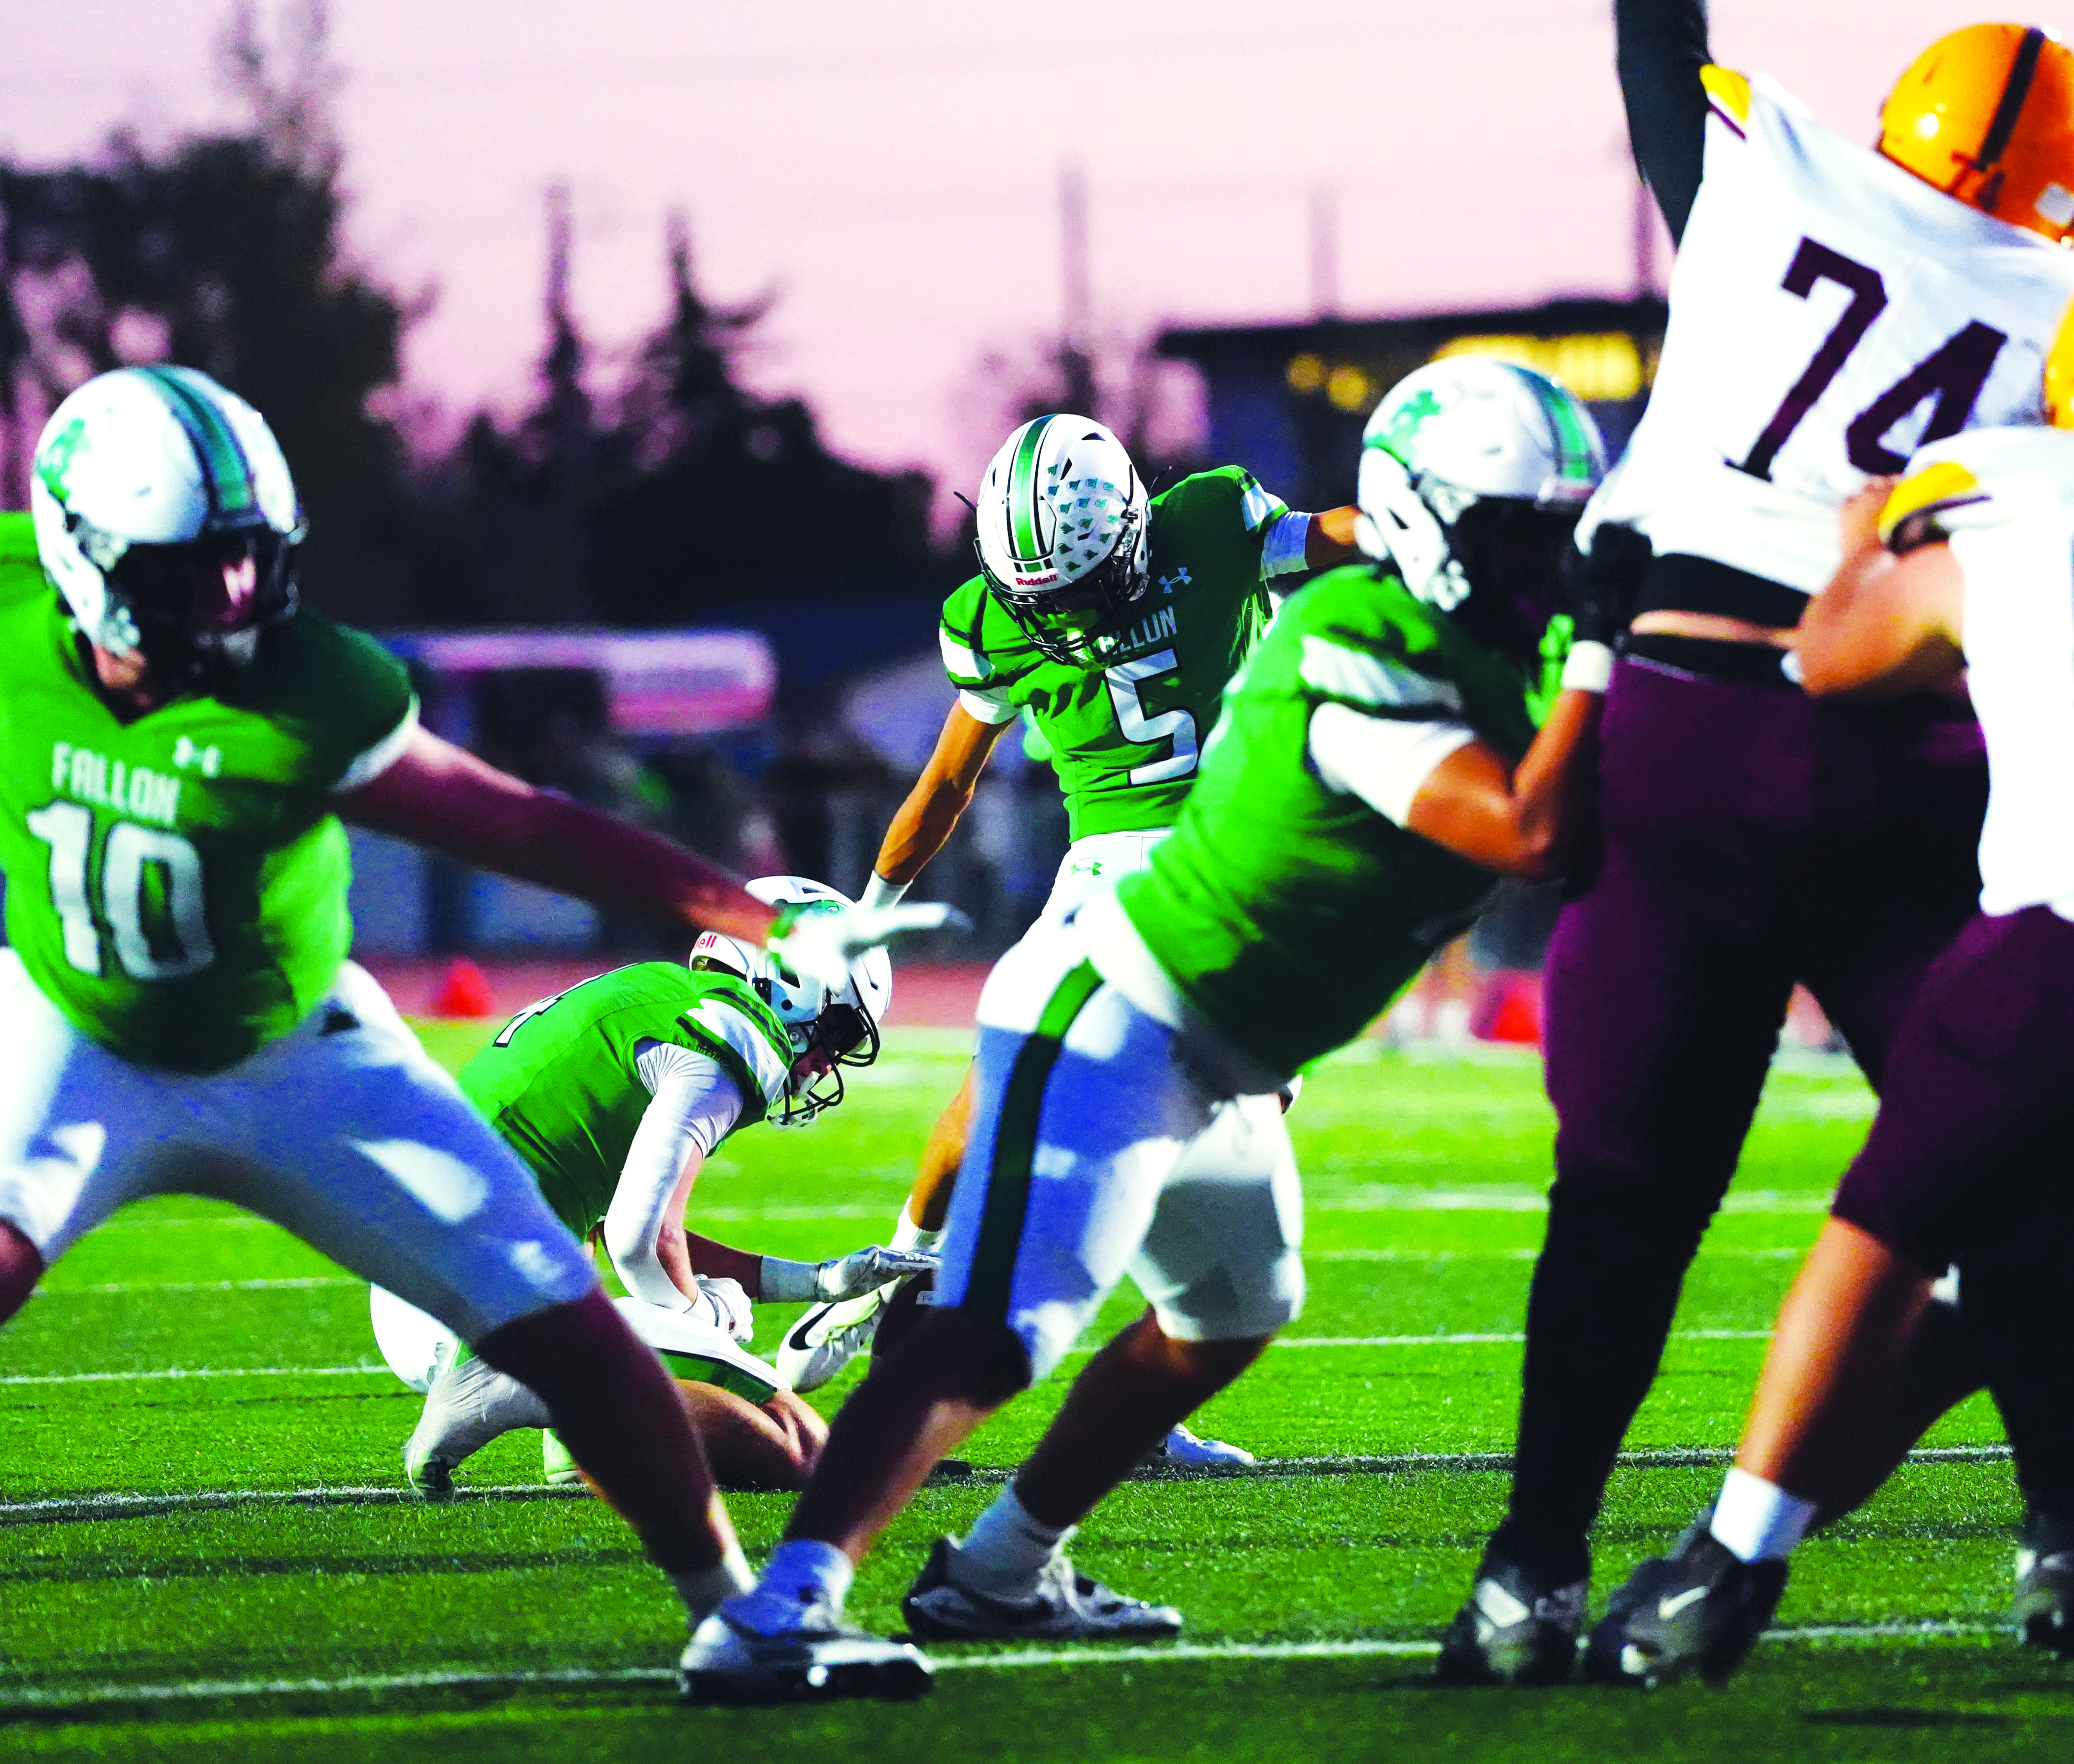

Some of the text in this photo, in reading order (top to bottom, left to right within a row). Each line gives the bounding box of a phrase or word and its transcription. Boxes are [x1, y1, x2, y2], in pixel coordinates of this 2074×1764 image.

[1724, 236, 2007, 482] 74
[1016, 574, 1057, 585] Riddell
[52, 742, 180, 825] FALLON
[1103, 647, 1199, 786] 5
[27, 802, 215, 980] 10
